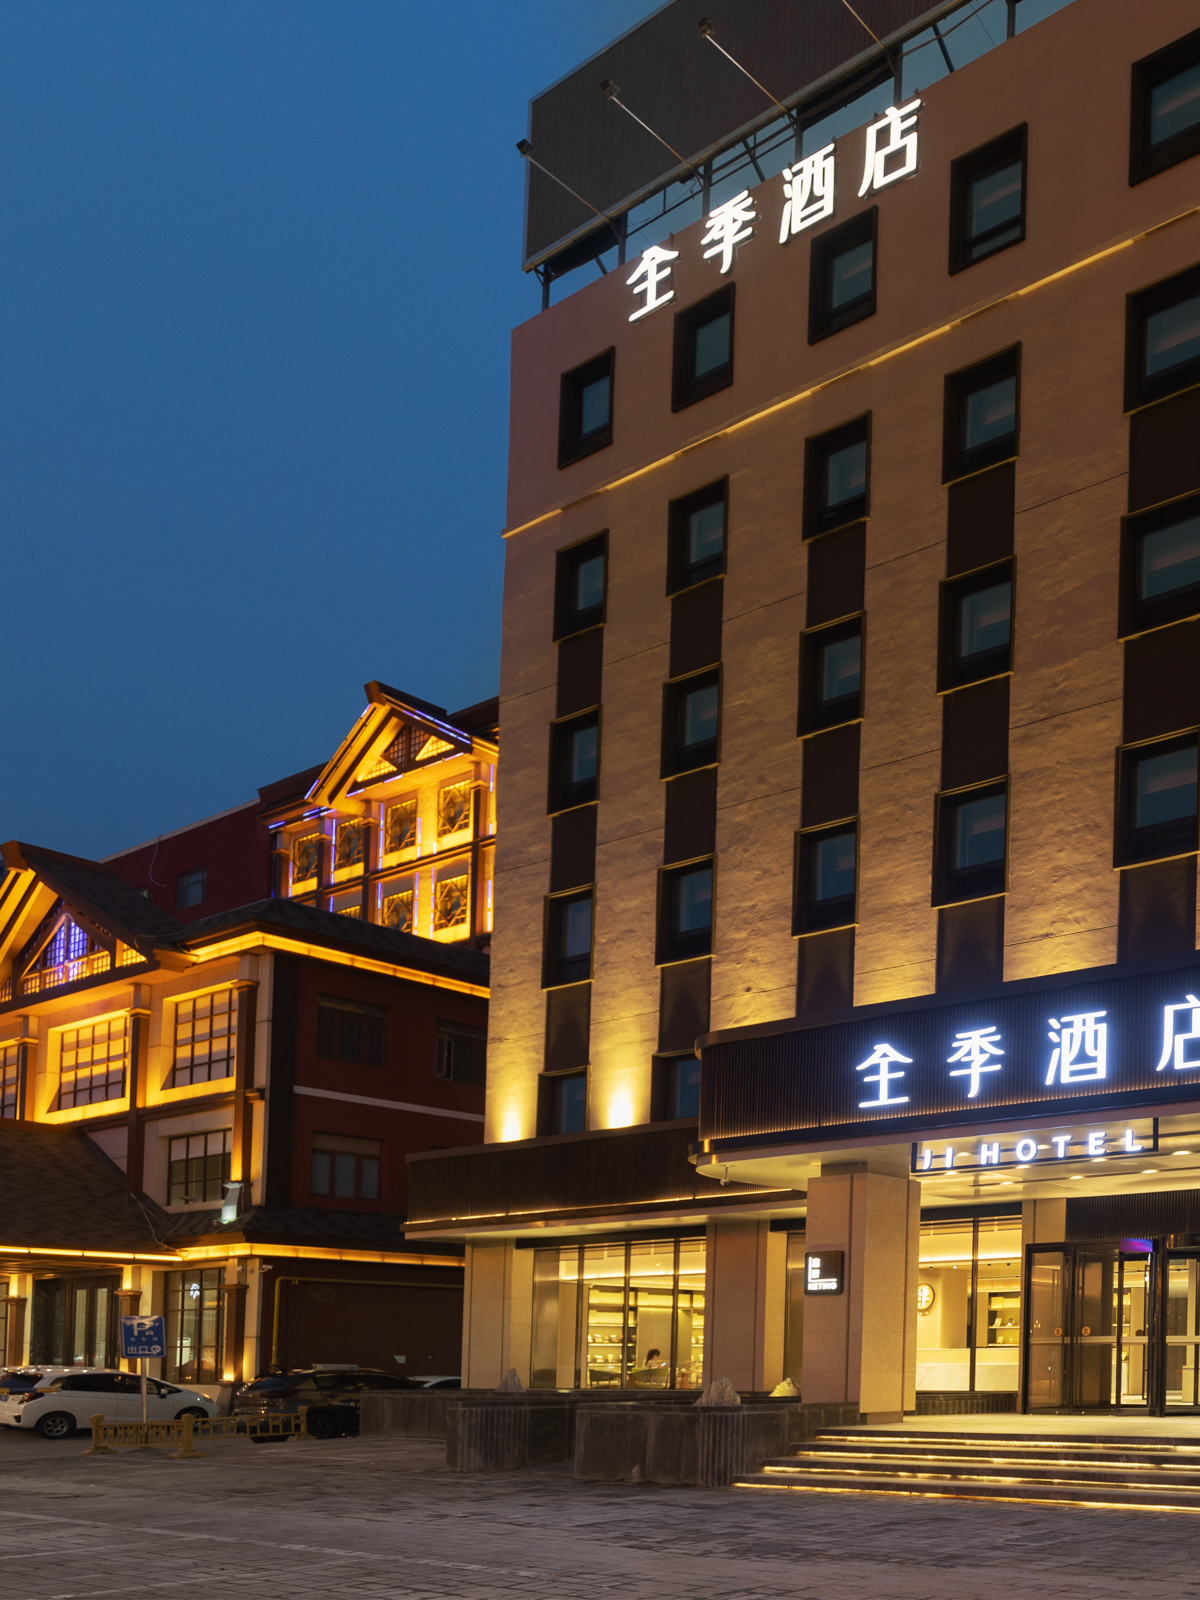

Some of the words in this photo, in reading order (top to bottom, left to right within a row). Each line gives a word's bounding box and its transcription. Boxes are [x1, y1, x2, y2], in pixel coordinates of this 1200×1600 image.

[626, 98, 923, 323] 全季酒店
[921, 1147, 954, 1171] JI
[977, 1128, 1144, 1165] HOTEL
[127, 1346, 148, 1354] 出口
